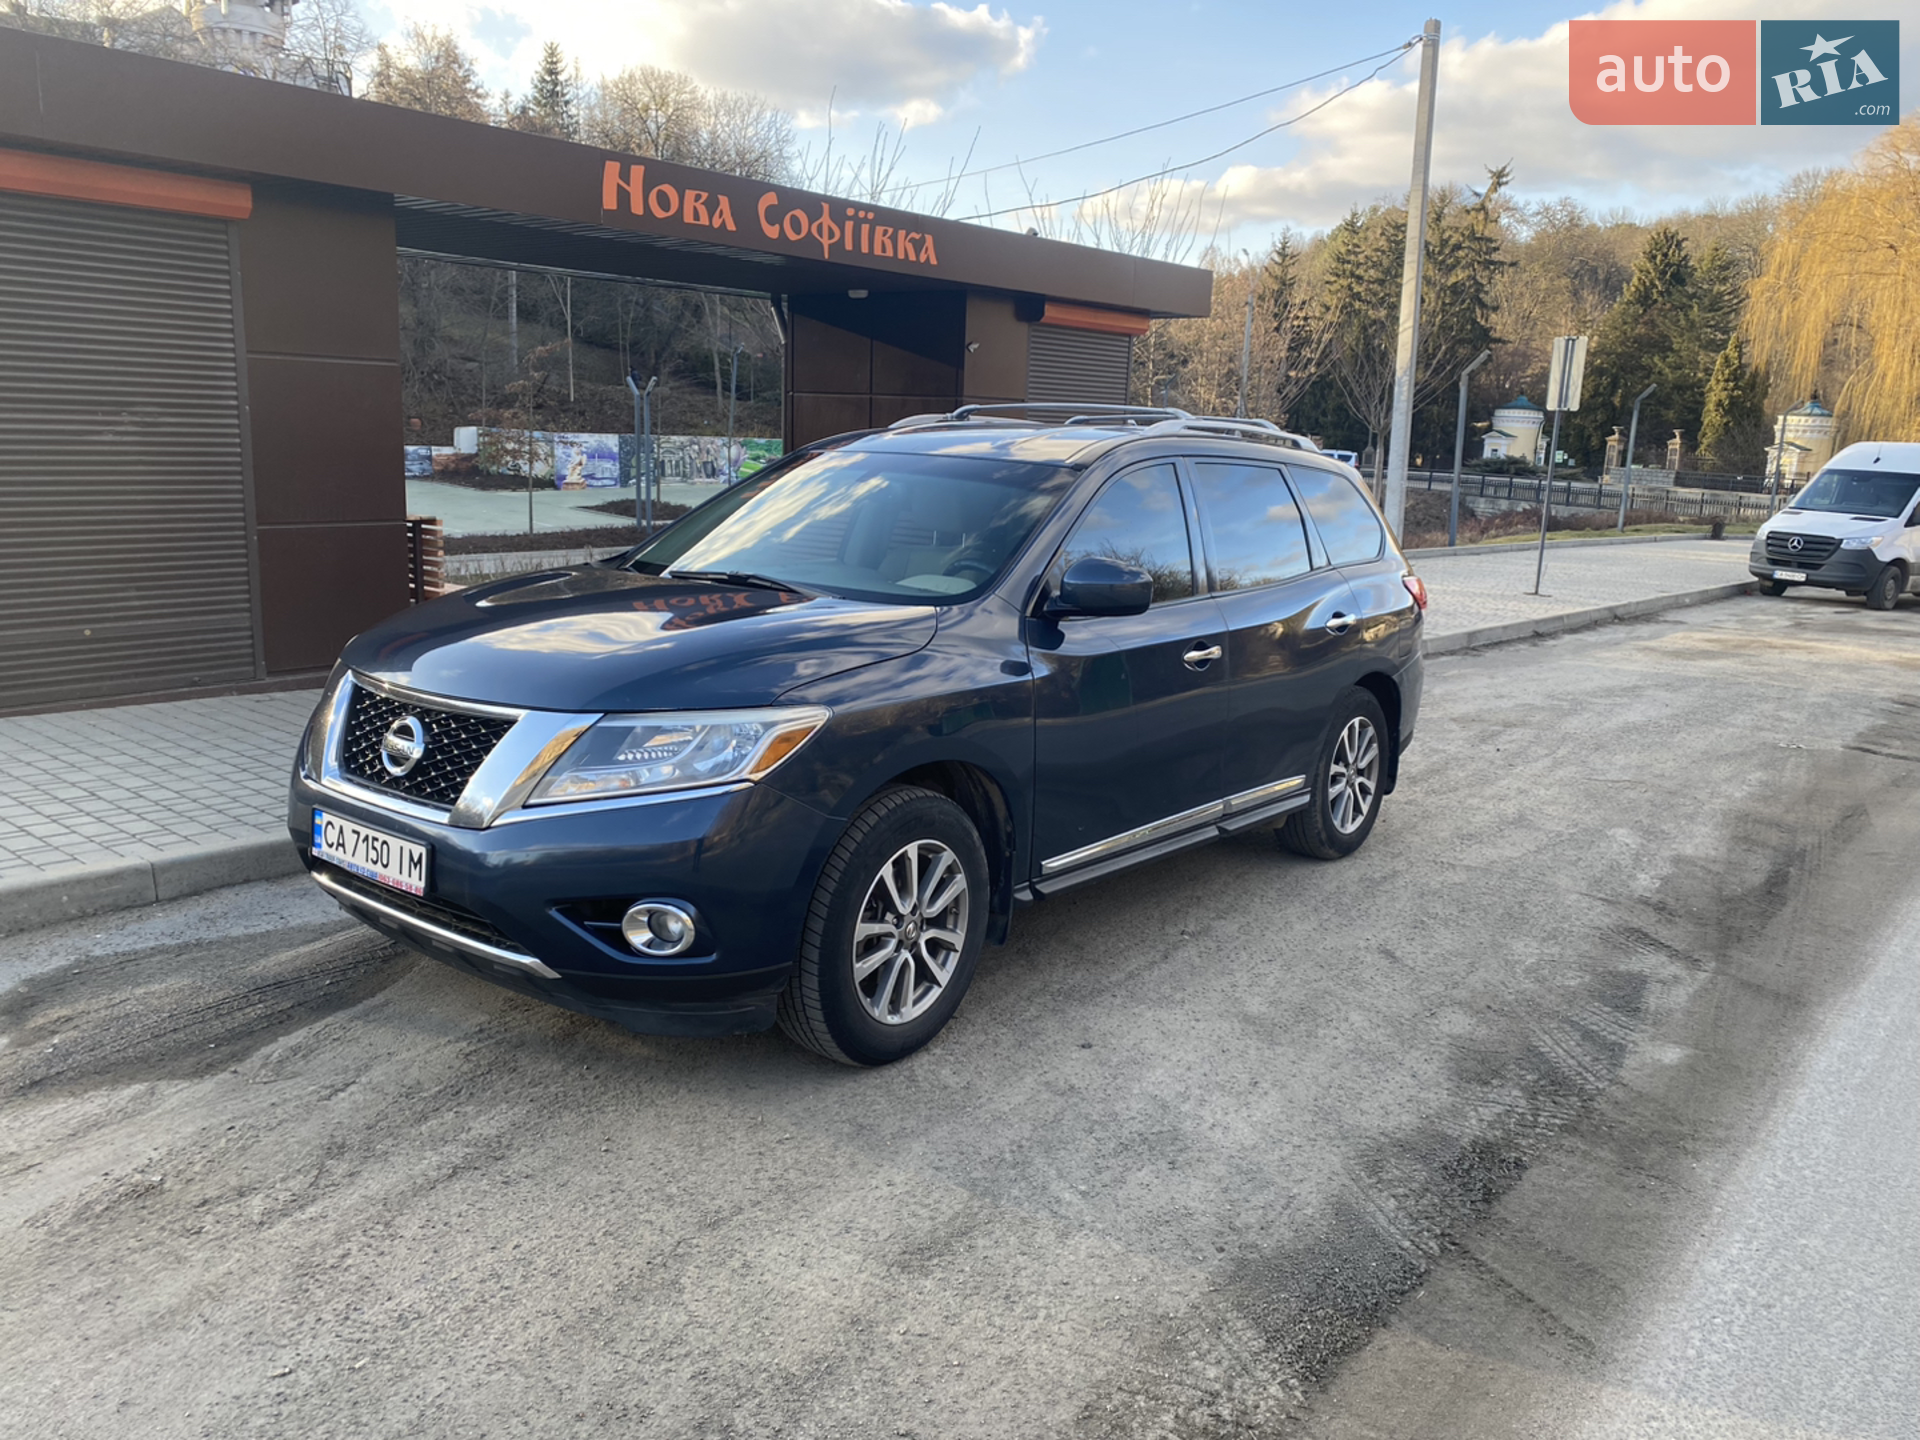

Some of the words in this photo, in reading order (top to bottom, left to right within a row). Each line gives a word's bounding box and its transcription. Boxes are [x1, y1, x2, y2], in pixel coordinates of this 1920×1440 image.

[323, 820, 347, 854] CA
[351, 829, 390, 869] 7150
[399, 844, 422, 882] IM
